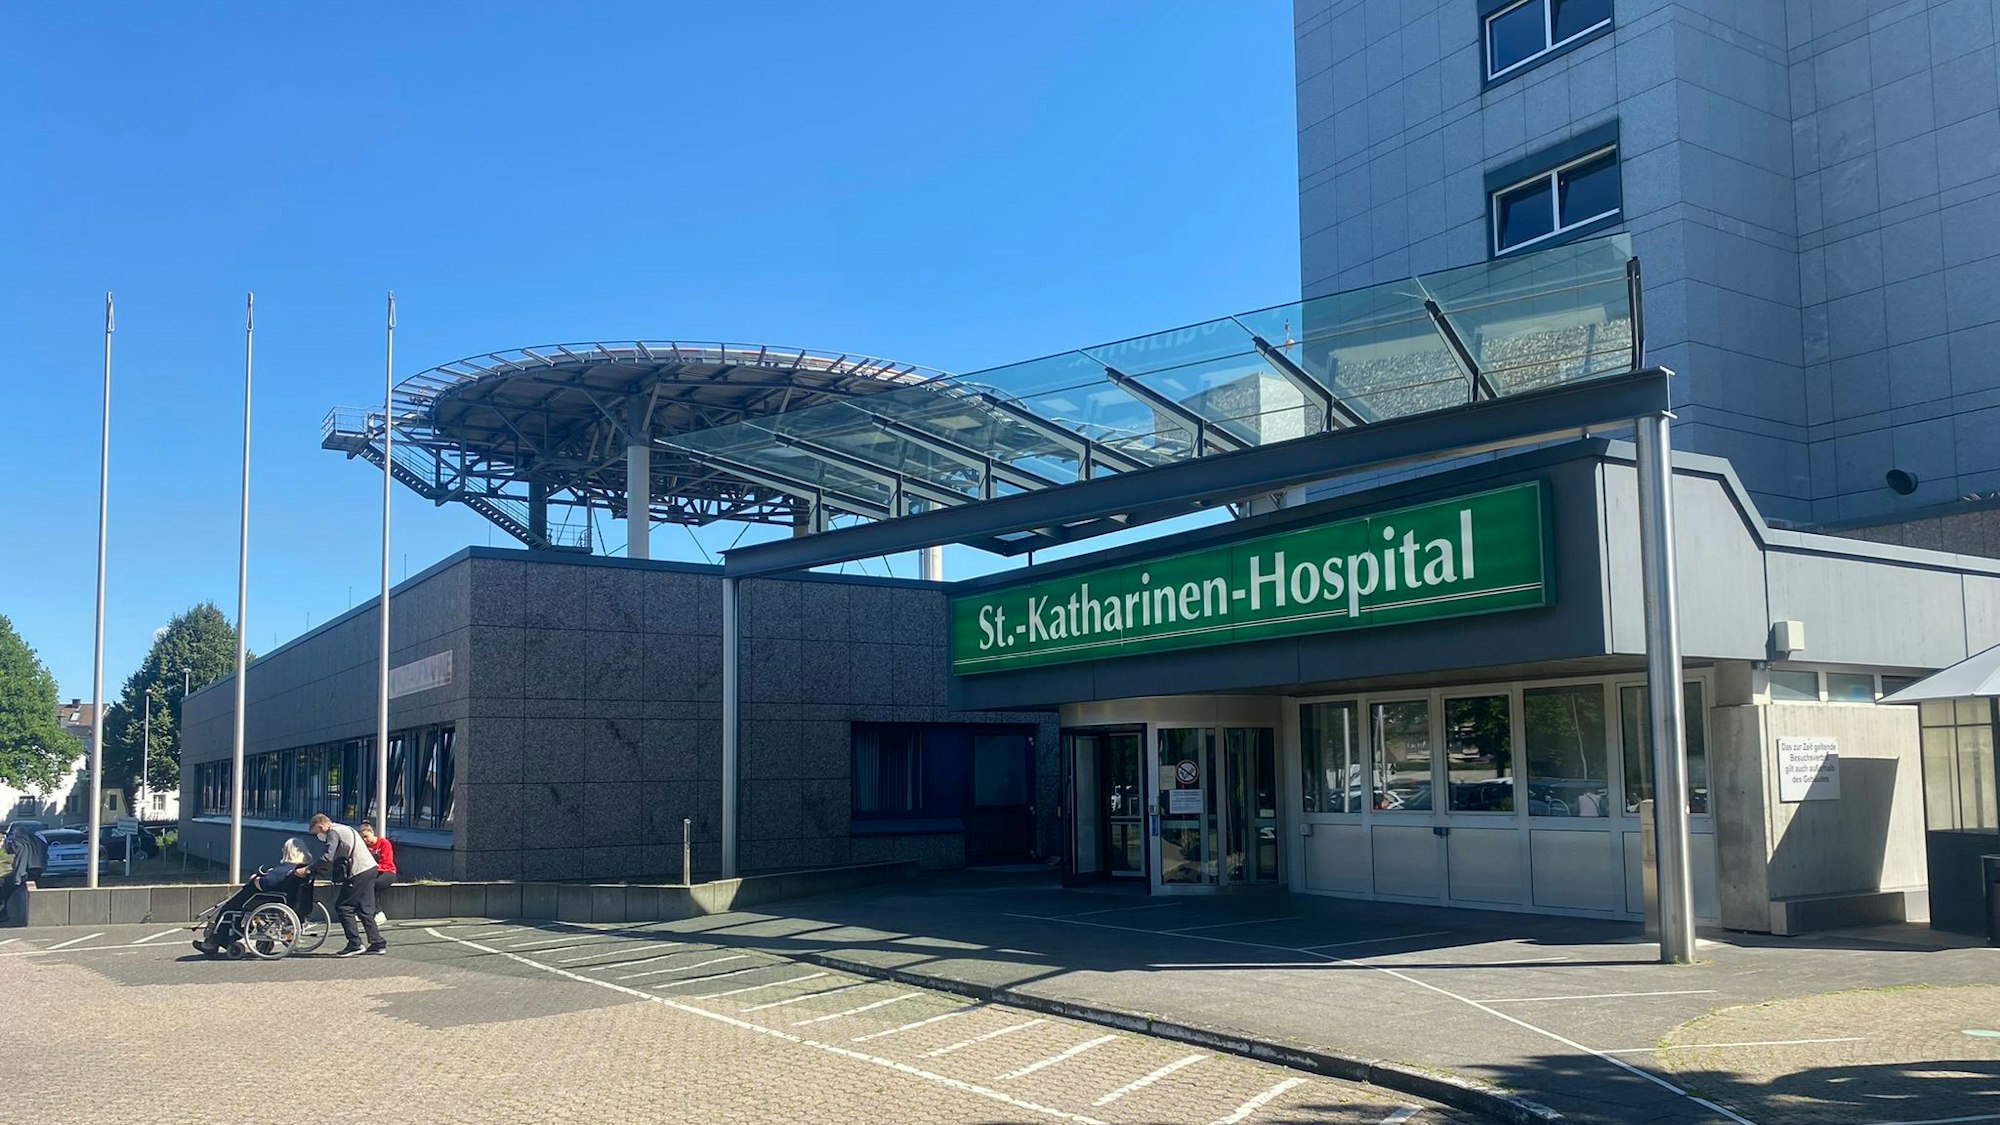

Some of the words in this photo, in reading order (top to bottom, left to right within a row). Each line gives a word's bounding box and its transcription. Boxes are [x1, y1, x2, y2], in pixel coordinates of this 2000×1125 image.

[979, 509, 1475, 650] St.-Katharinen-Hospital
[1781, 742, 1792, 751] Das
[1802, 742, 1813, 751] Zeit
[1814, 743, 1836, 752] geltende
[1785, 764, 1794, 774] gilt
[1795, 764, 1807, 772] auch
